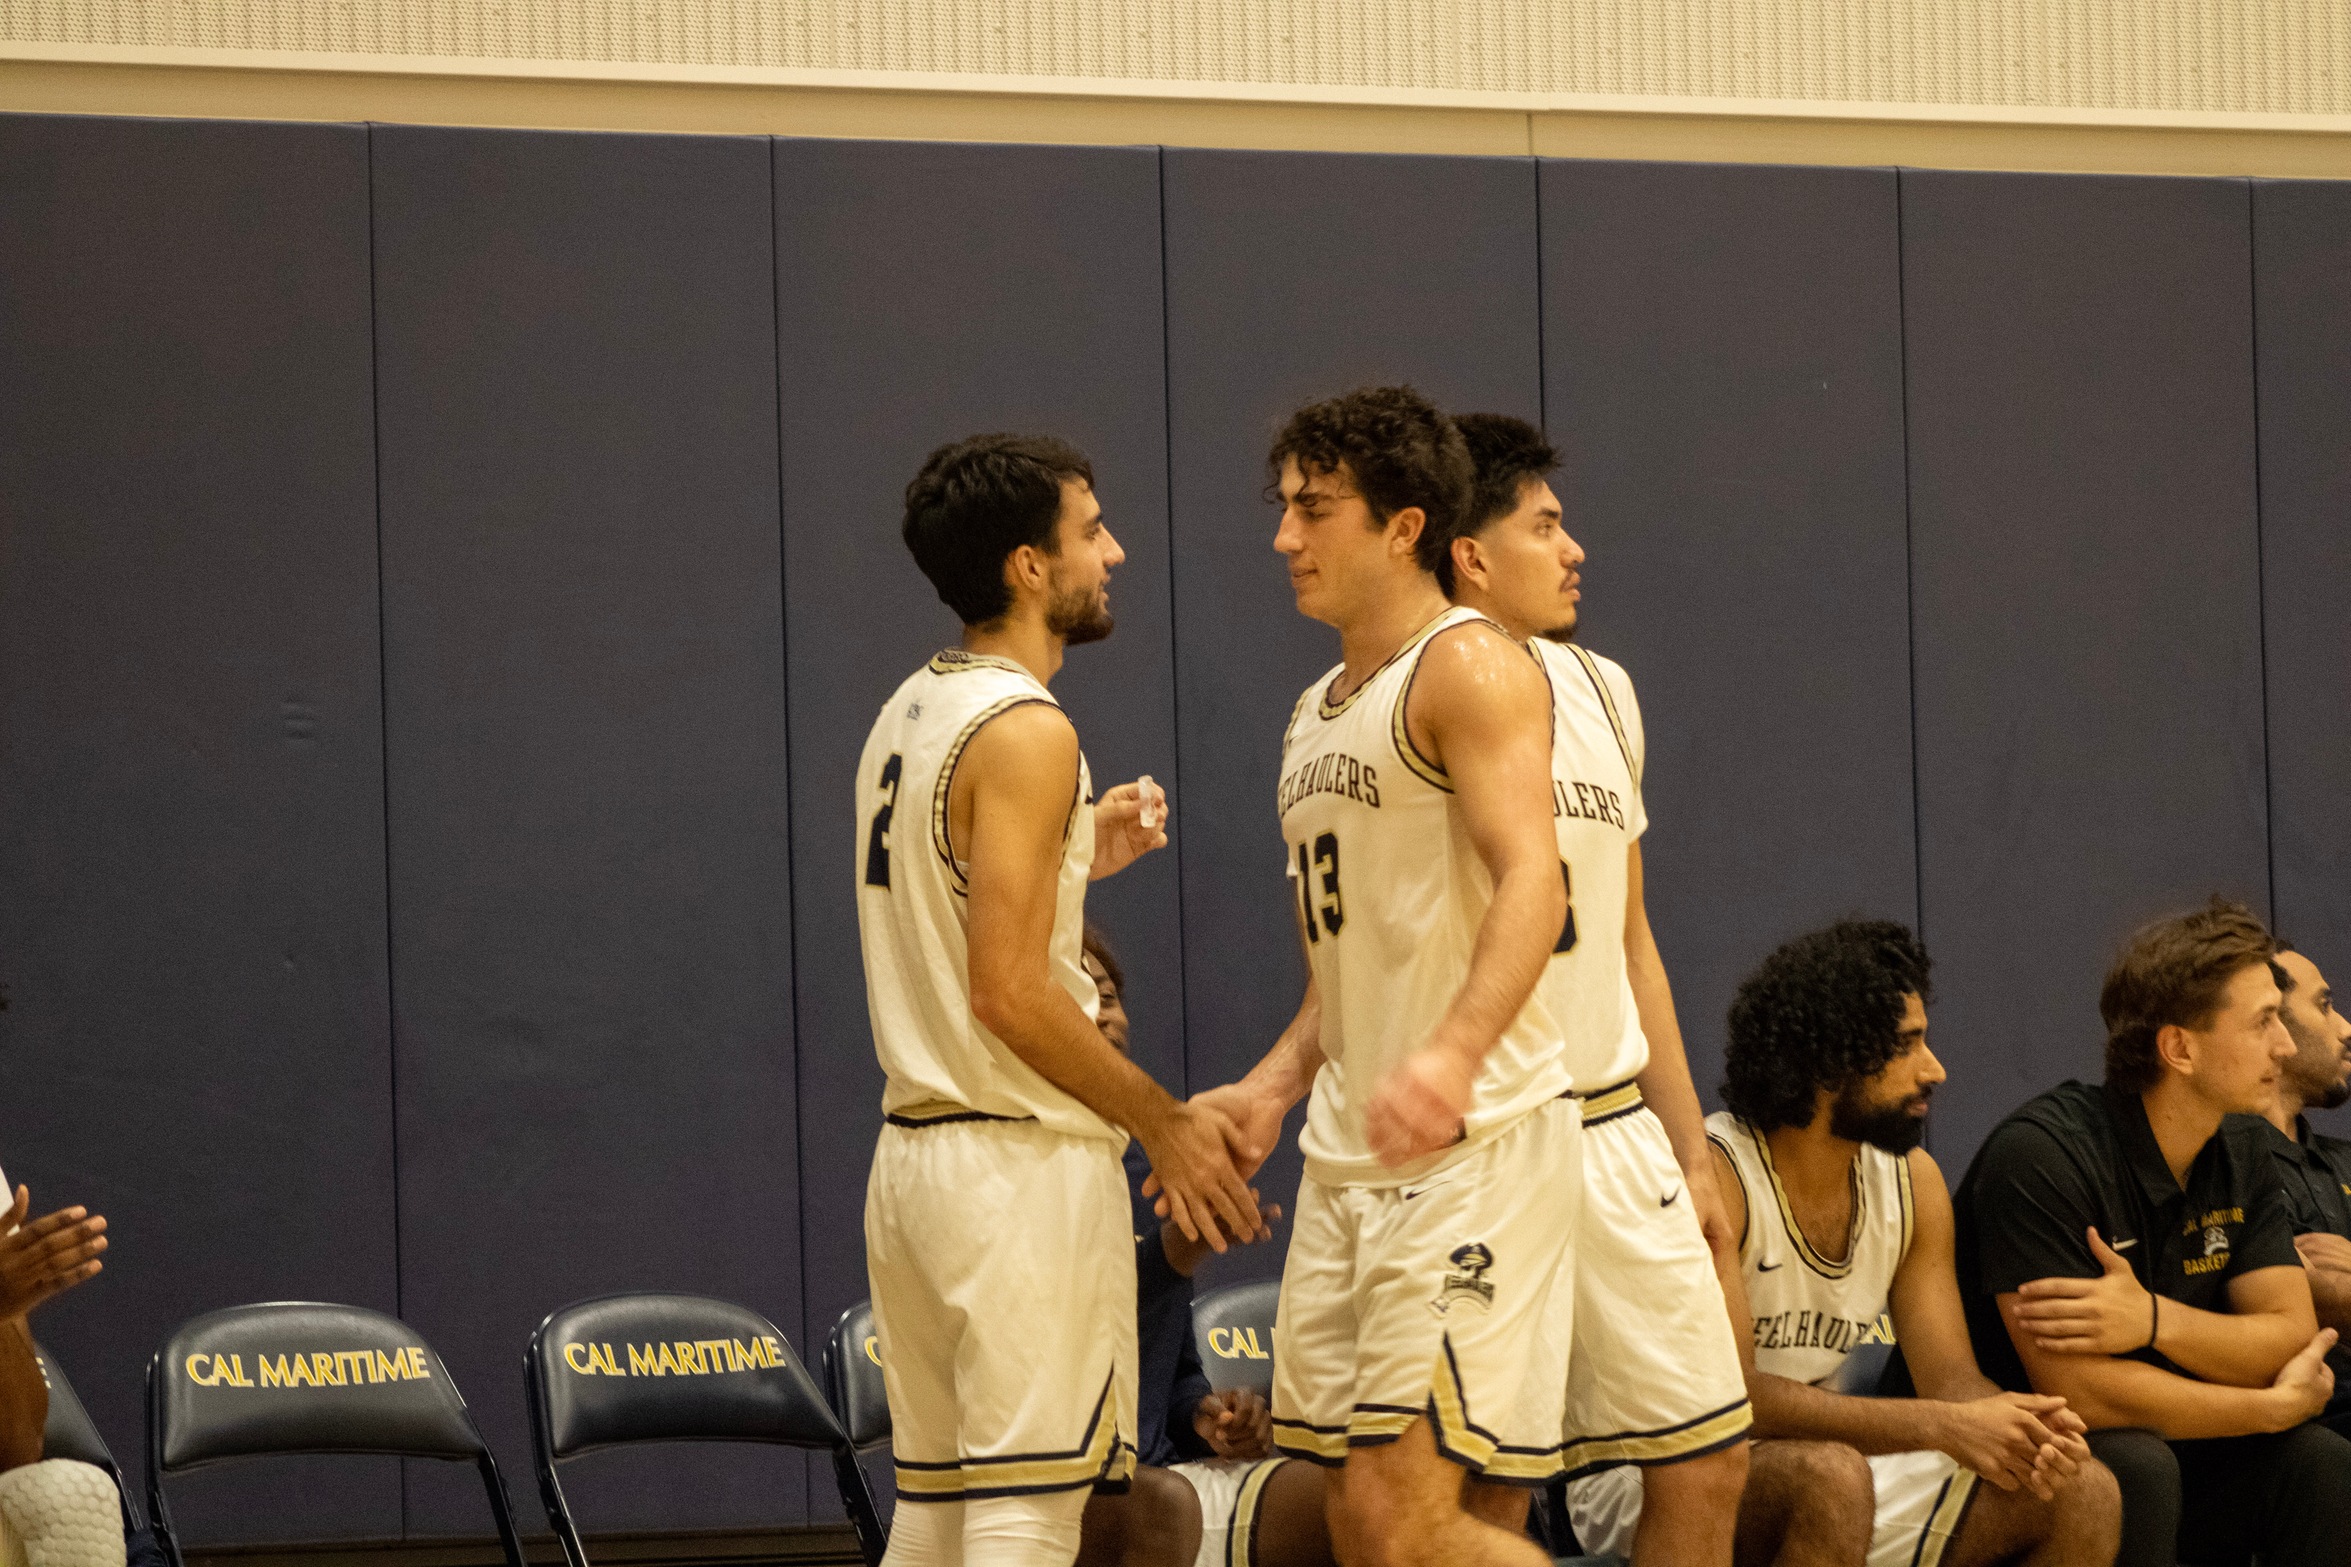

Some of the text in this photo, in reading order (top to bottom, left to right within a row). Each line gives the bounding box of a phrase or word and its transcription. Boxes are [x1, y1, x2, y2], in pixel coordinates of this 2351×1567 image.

[865, 753, 903, 889] 2
[1297, 829, 1345, 946] 13
[1207, 1326, 1270, 1360] CAL
[1860, 1313, 1897, 1345] AL
[185, 1346, 431, 1388] CAL MARITIME
[563, 1336, 786, 1377] CAL MARITIME
